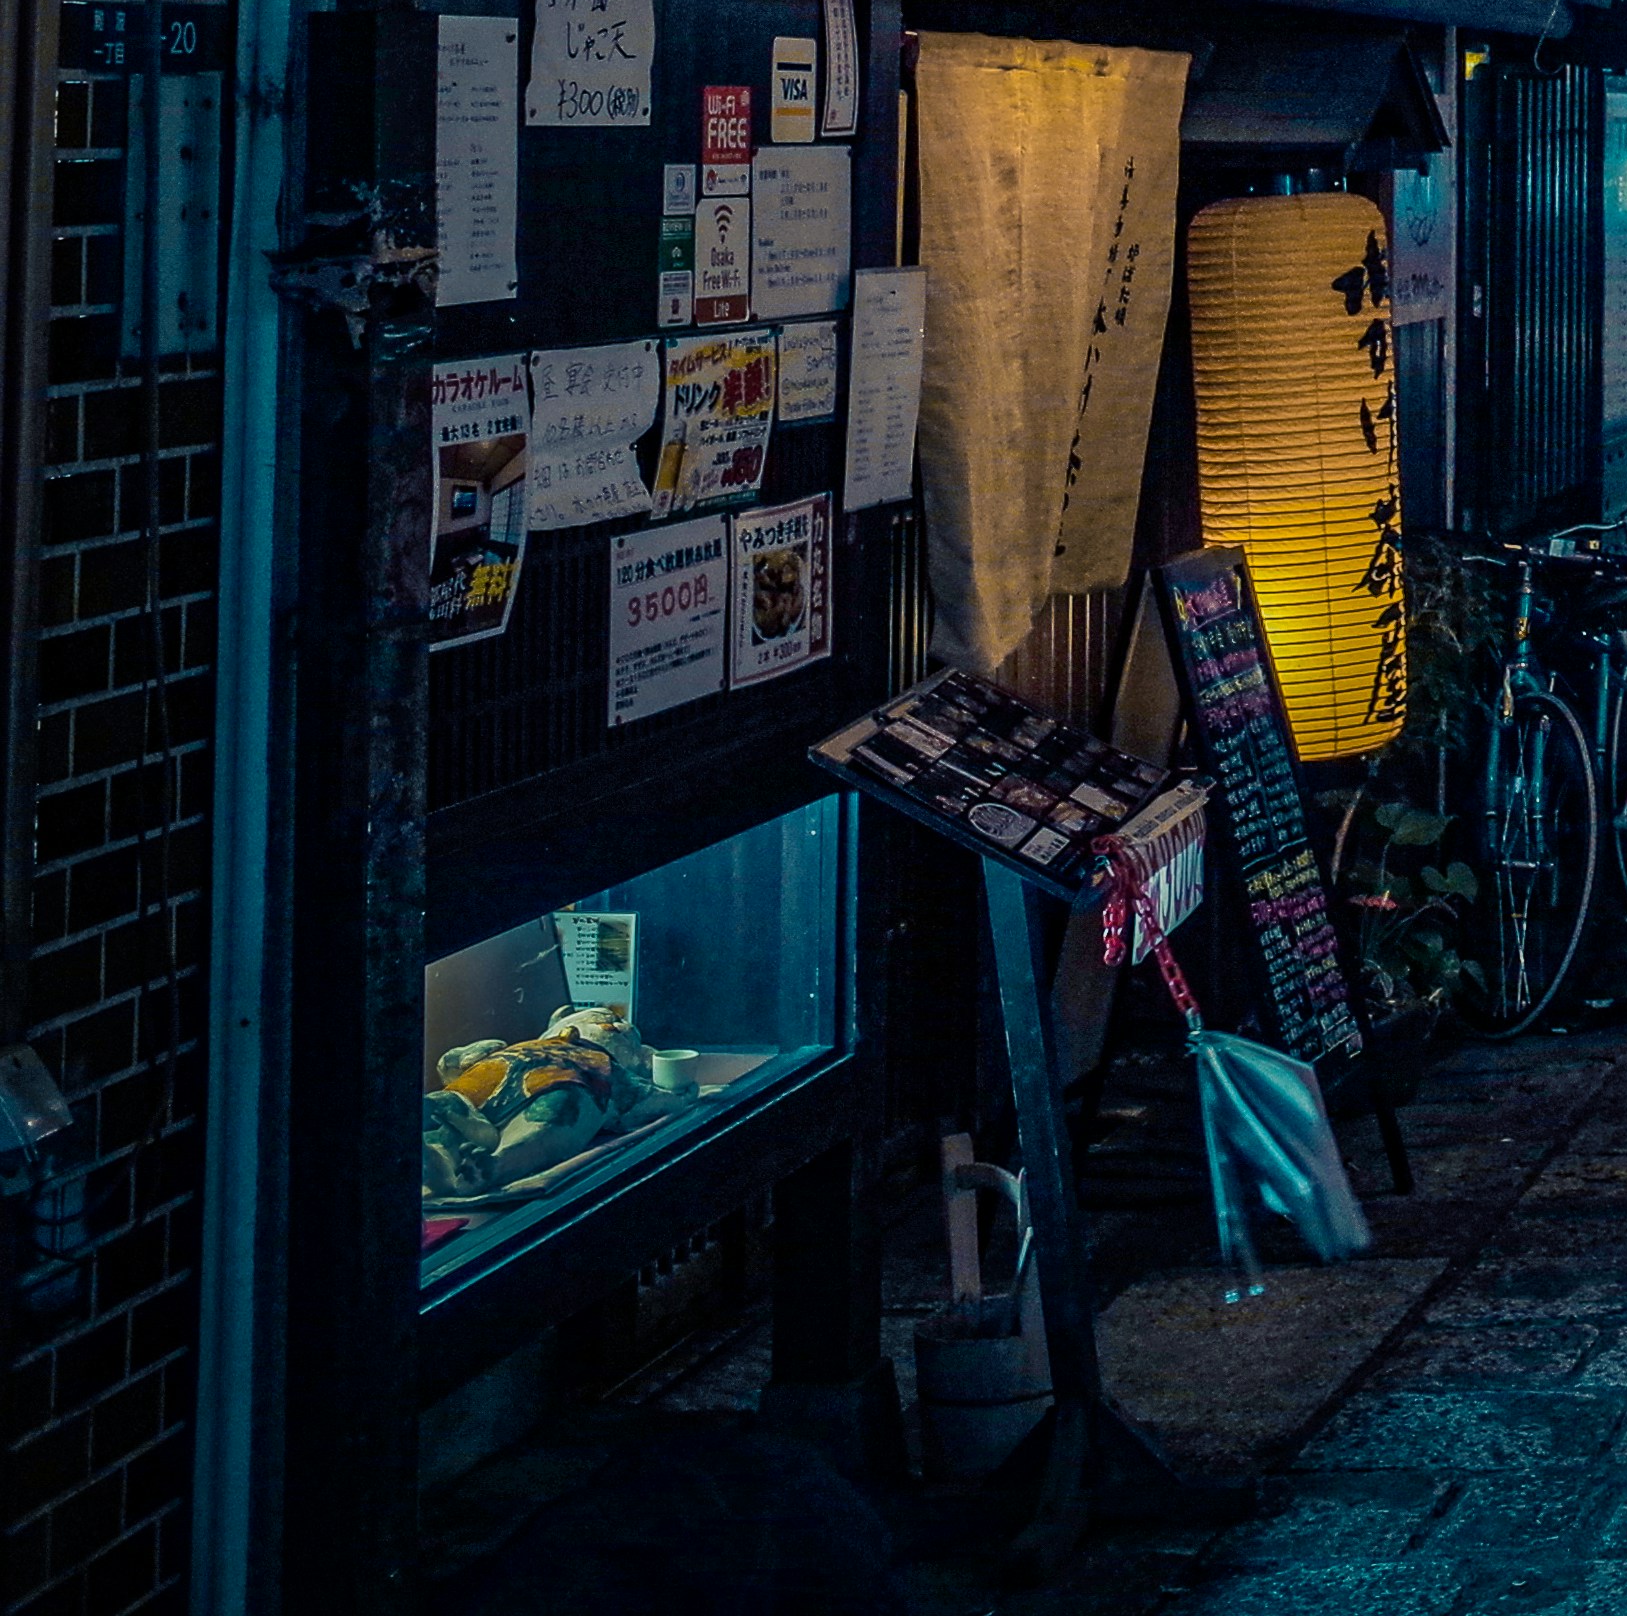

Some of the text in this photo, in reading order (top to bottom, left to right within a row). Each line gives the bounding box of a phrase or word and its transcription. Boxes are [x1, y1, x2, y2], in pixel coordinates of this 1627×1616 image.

[781, 78, 808, 101] VISA
[707, 117, 747, 150] FREE
[711, 246, 735, 267] Osaka
[713, 300, 730, 319] Lite
[432, 364, 524, 405] カラオケルーム
[674, 380, 721, 417] ドリンク
